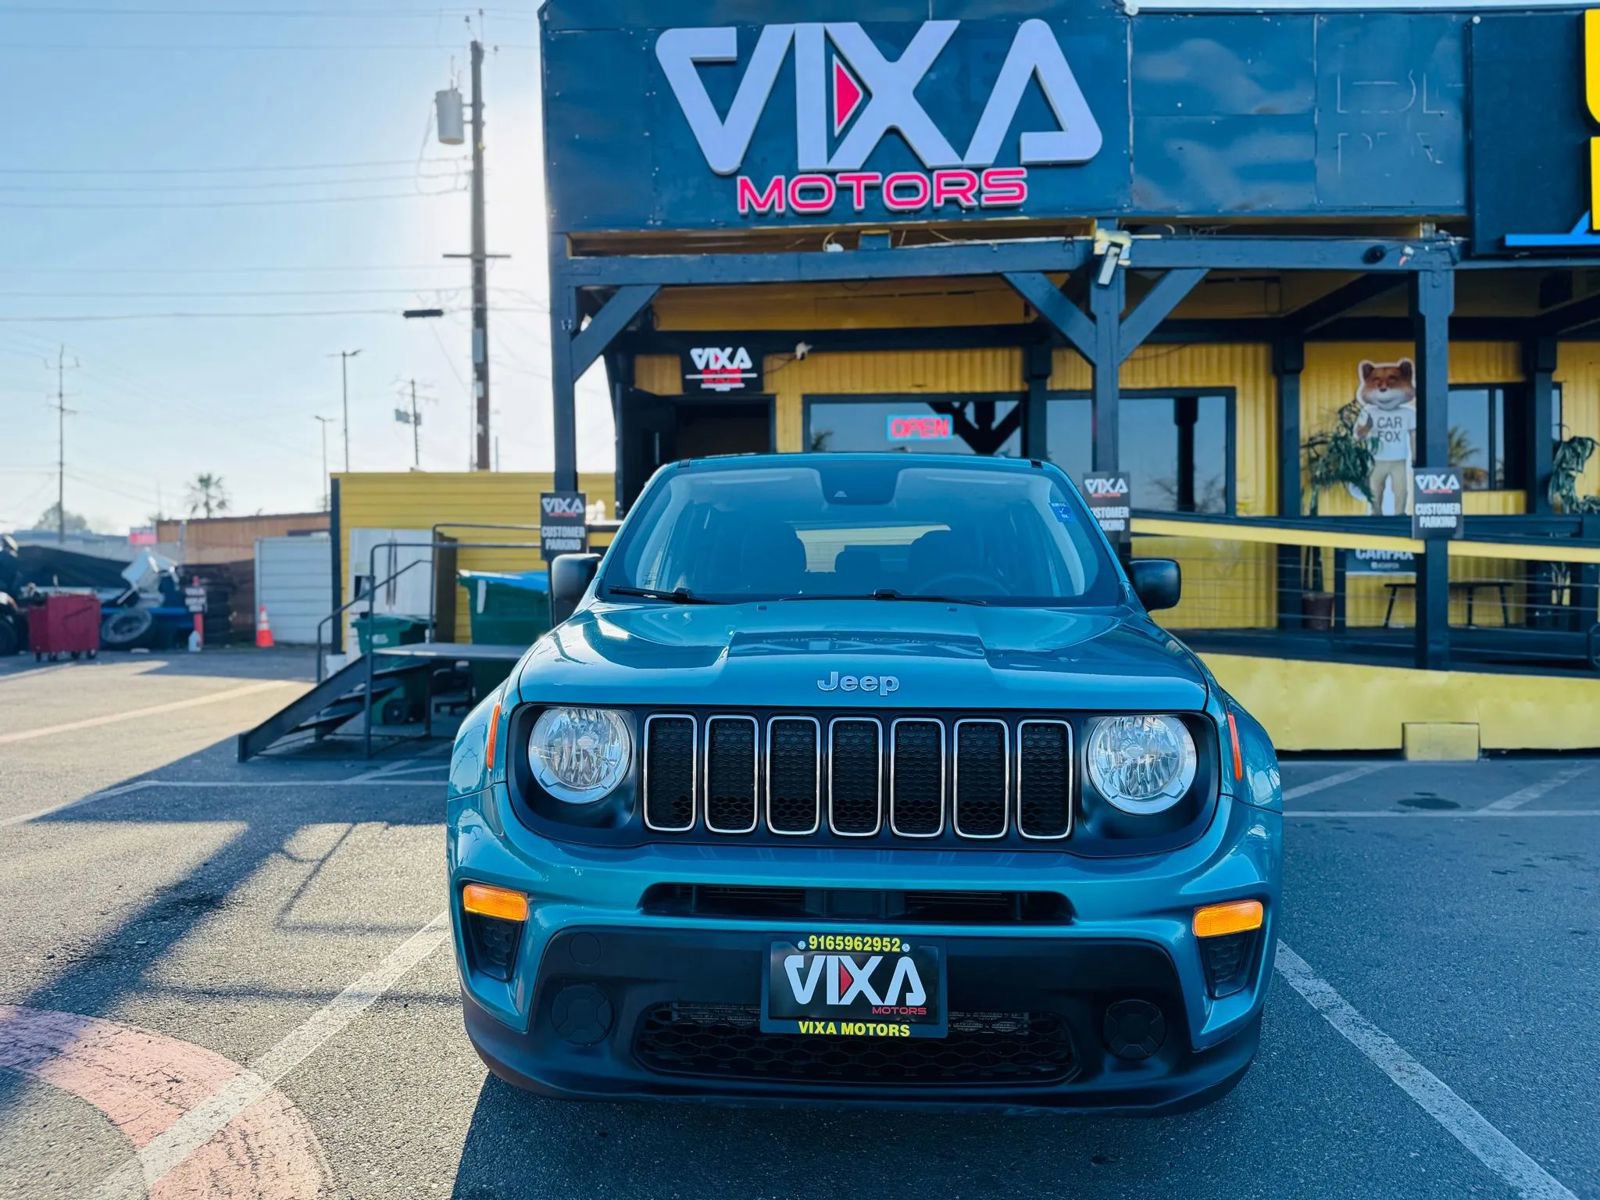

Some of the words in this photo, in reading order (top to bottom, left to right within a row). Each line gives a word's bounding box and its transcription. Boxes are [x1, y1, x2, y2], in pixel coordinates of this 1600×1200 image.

[655, 18, 1103, 176] VIXA
[737, 167, 1028, 215] MOTORS
[690, 346, 753, 370] VIXA
[890, 417, 949, 438] OPEN
[1377, 416, 1402, 429] CAR
[1378, 431, 1401, 442] FOX
[1084, 478, 1129, 494] VIXA
[1415, 474, 1460, 490] VIXA
[542, 498, 584, 513] VIXA
[1090, 506, 1130, 518] STOMER
[1415, 503, 1461, 515] CUSTOMER
[1419, 515, 1457, 528] PARKING
[542, 526, 586, 538] CUSTOMER
[545, 538, 581, 551] PARKING
[817, 671, 900, 696] Jeep
[808, 935, 901, 952] 9165962952
[784, 954, 927, 1006] VIXA
[872, 1007, 927, 1015] MOTORS
[798, 1021, 838, 1036] VIXA
[841, 1022, 910, 1037] MOTORS
